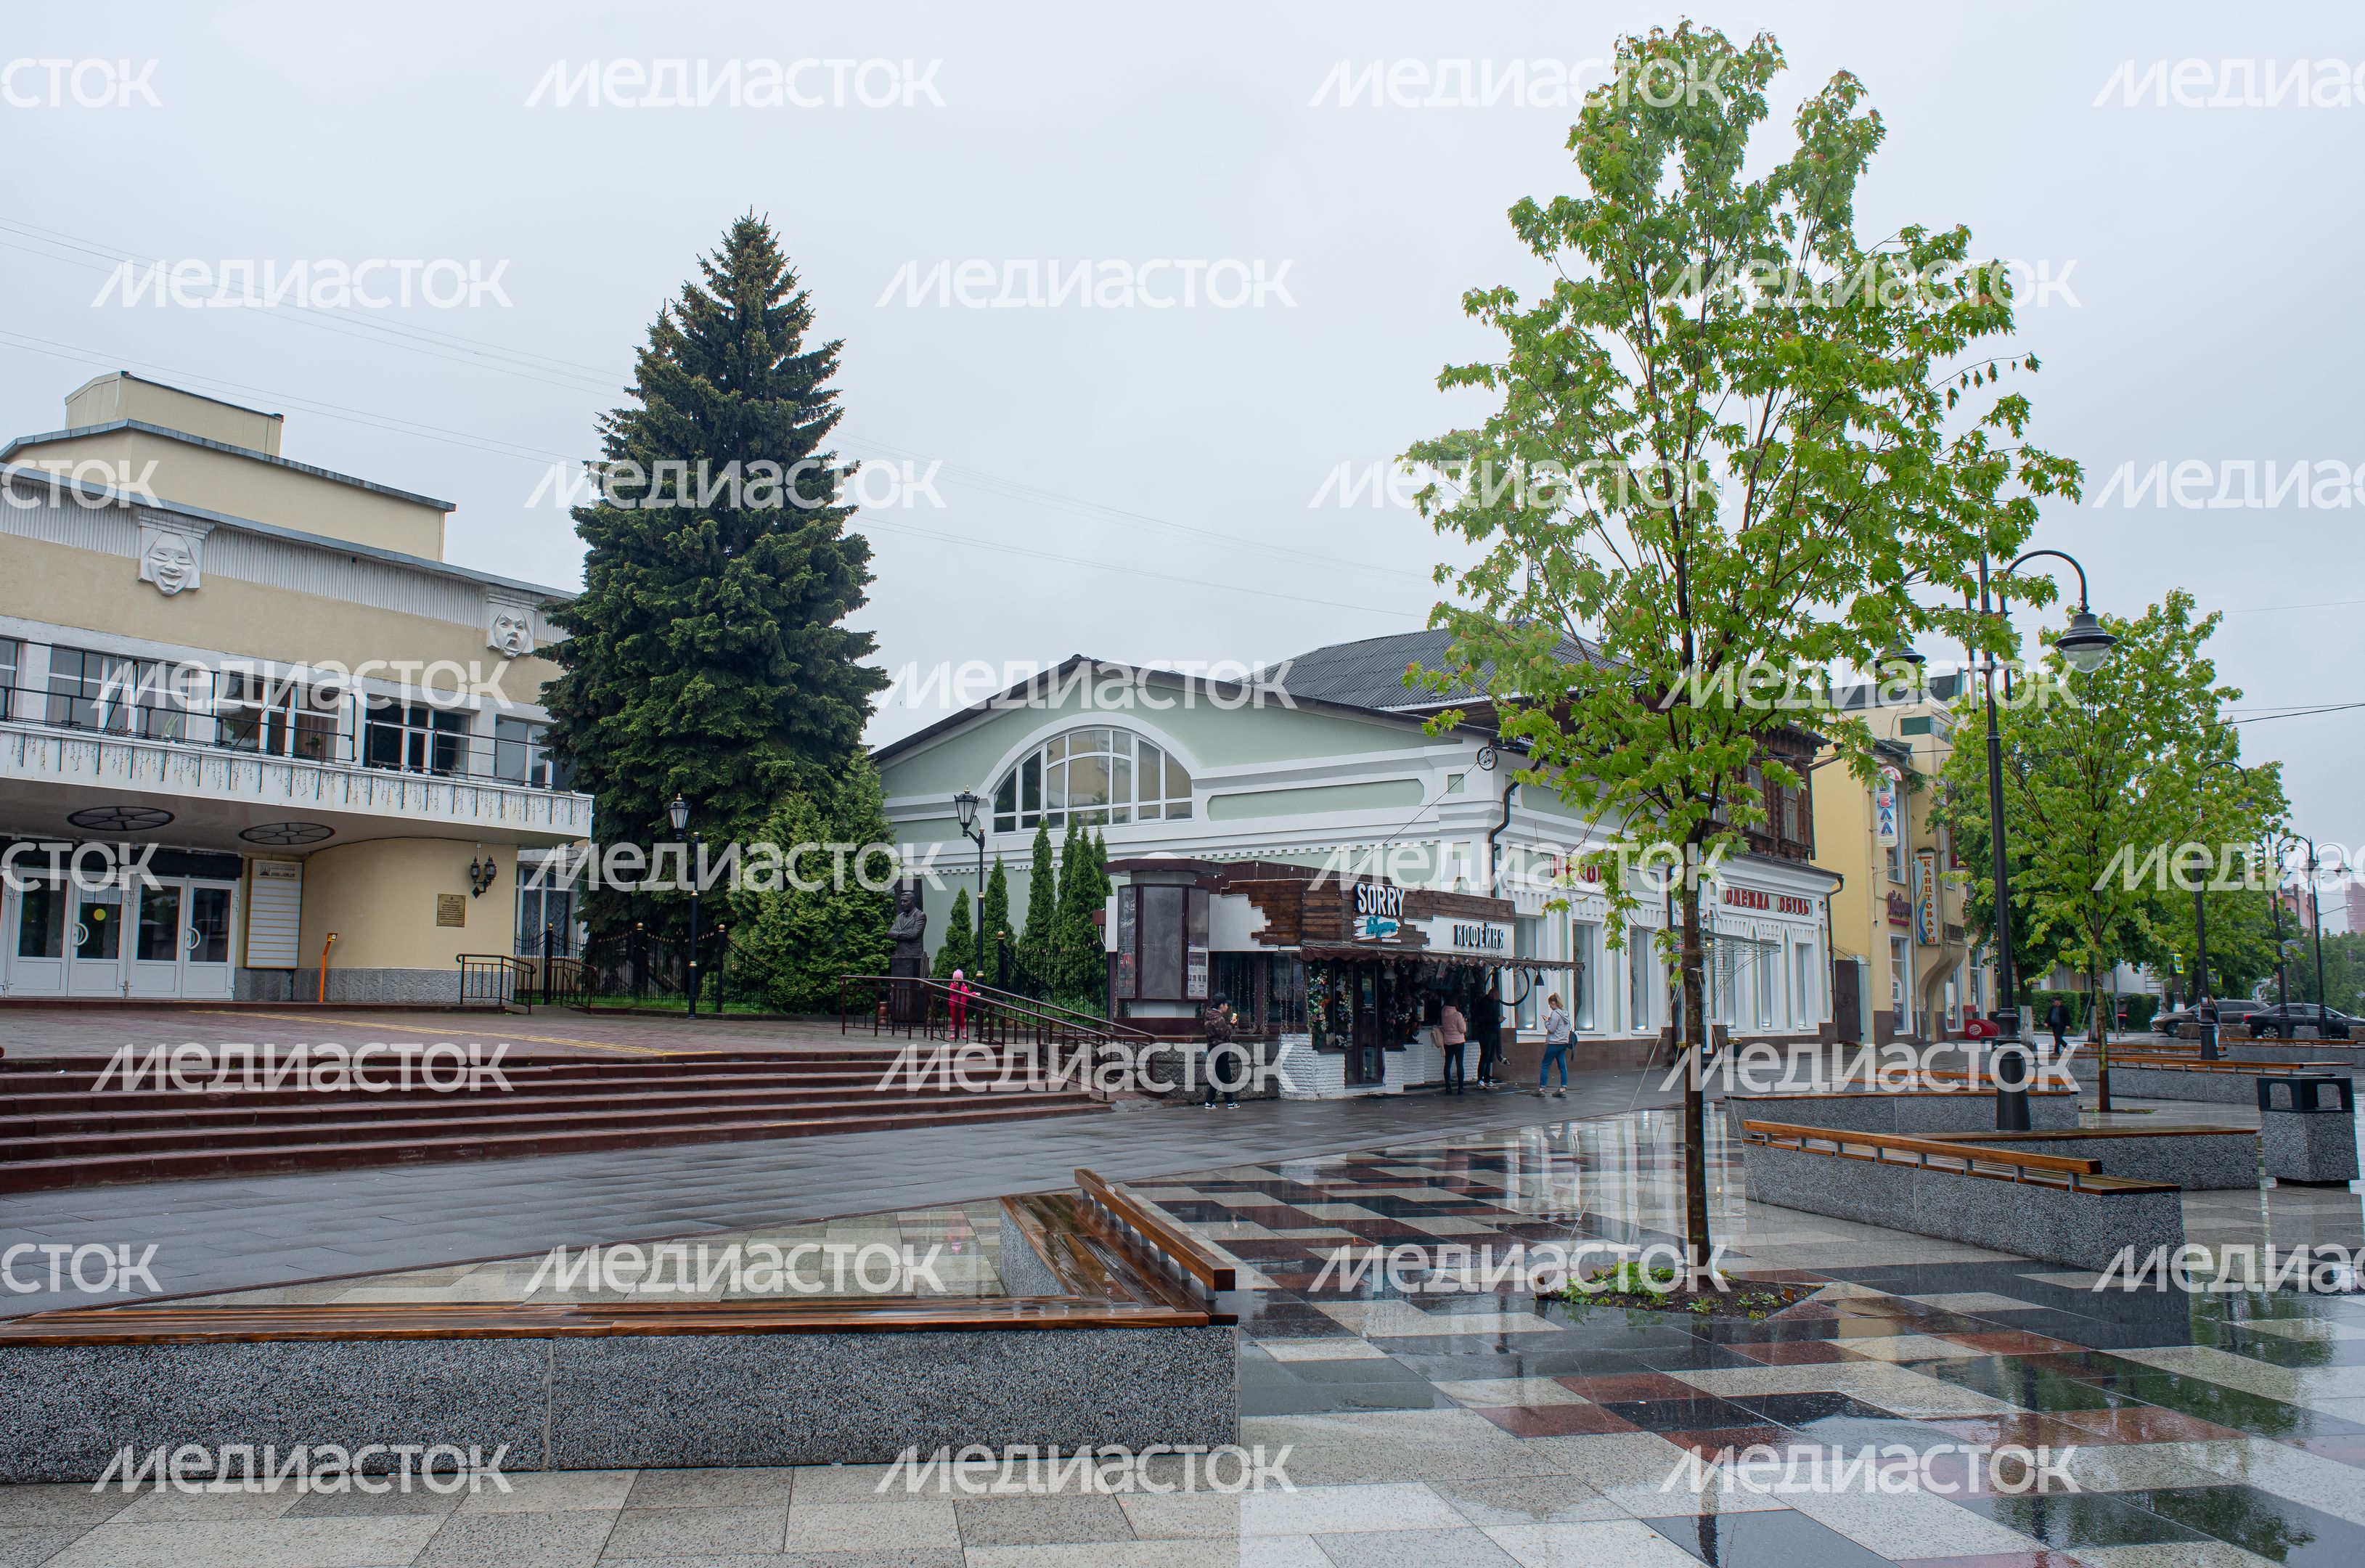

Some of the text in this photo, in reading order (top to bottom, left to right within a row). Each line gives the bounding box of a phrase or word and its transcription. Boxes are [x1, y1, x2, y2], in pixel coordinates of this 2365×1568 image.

[1356, 883, 1405, 916] SORRY
[1725, 887, 1809, 915] ОДЕЖДА ОБУВЬ
[1924, 860, 1937, 943] КАНЦТОВАРЫ
[1453, 922, 1505, 949] КОФЕЙНЯ
